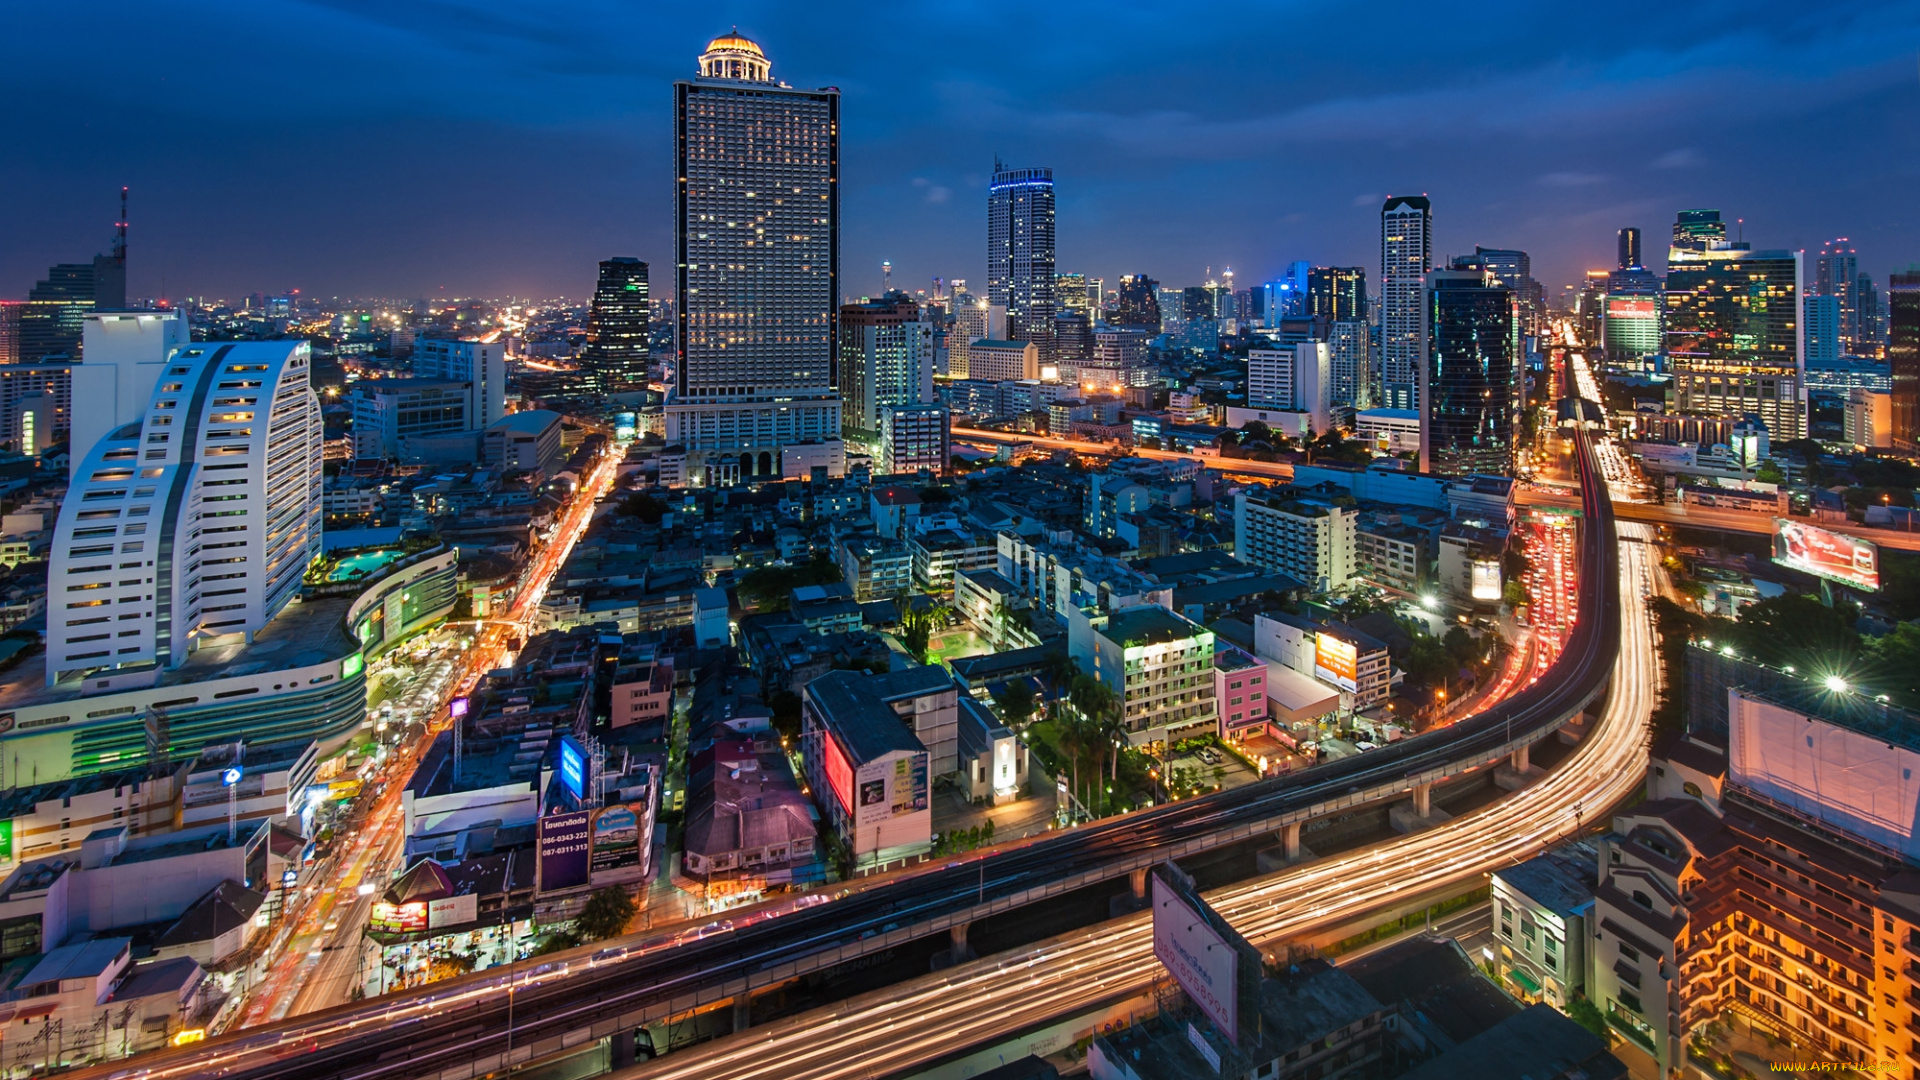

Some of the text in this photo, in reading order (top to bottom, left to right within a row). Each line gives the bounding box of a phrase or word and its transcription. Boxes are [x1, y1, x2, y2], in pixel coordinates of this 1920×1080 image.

[542, 831, 588, 844] 086-0343-222
[542, 843, 588, 856] 087-0311-313
[1157, 937, 1229, 1023] 089-8958995
